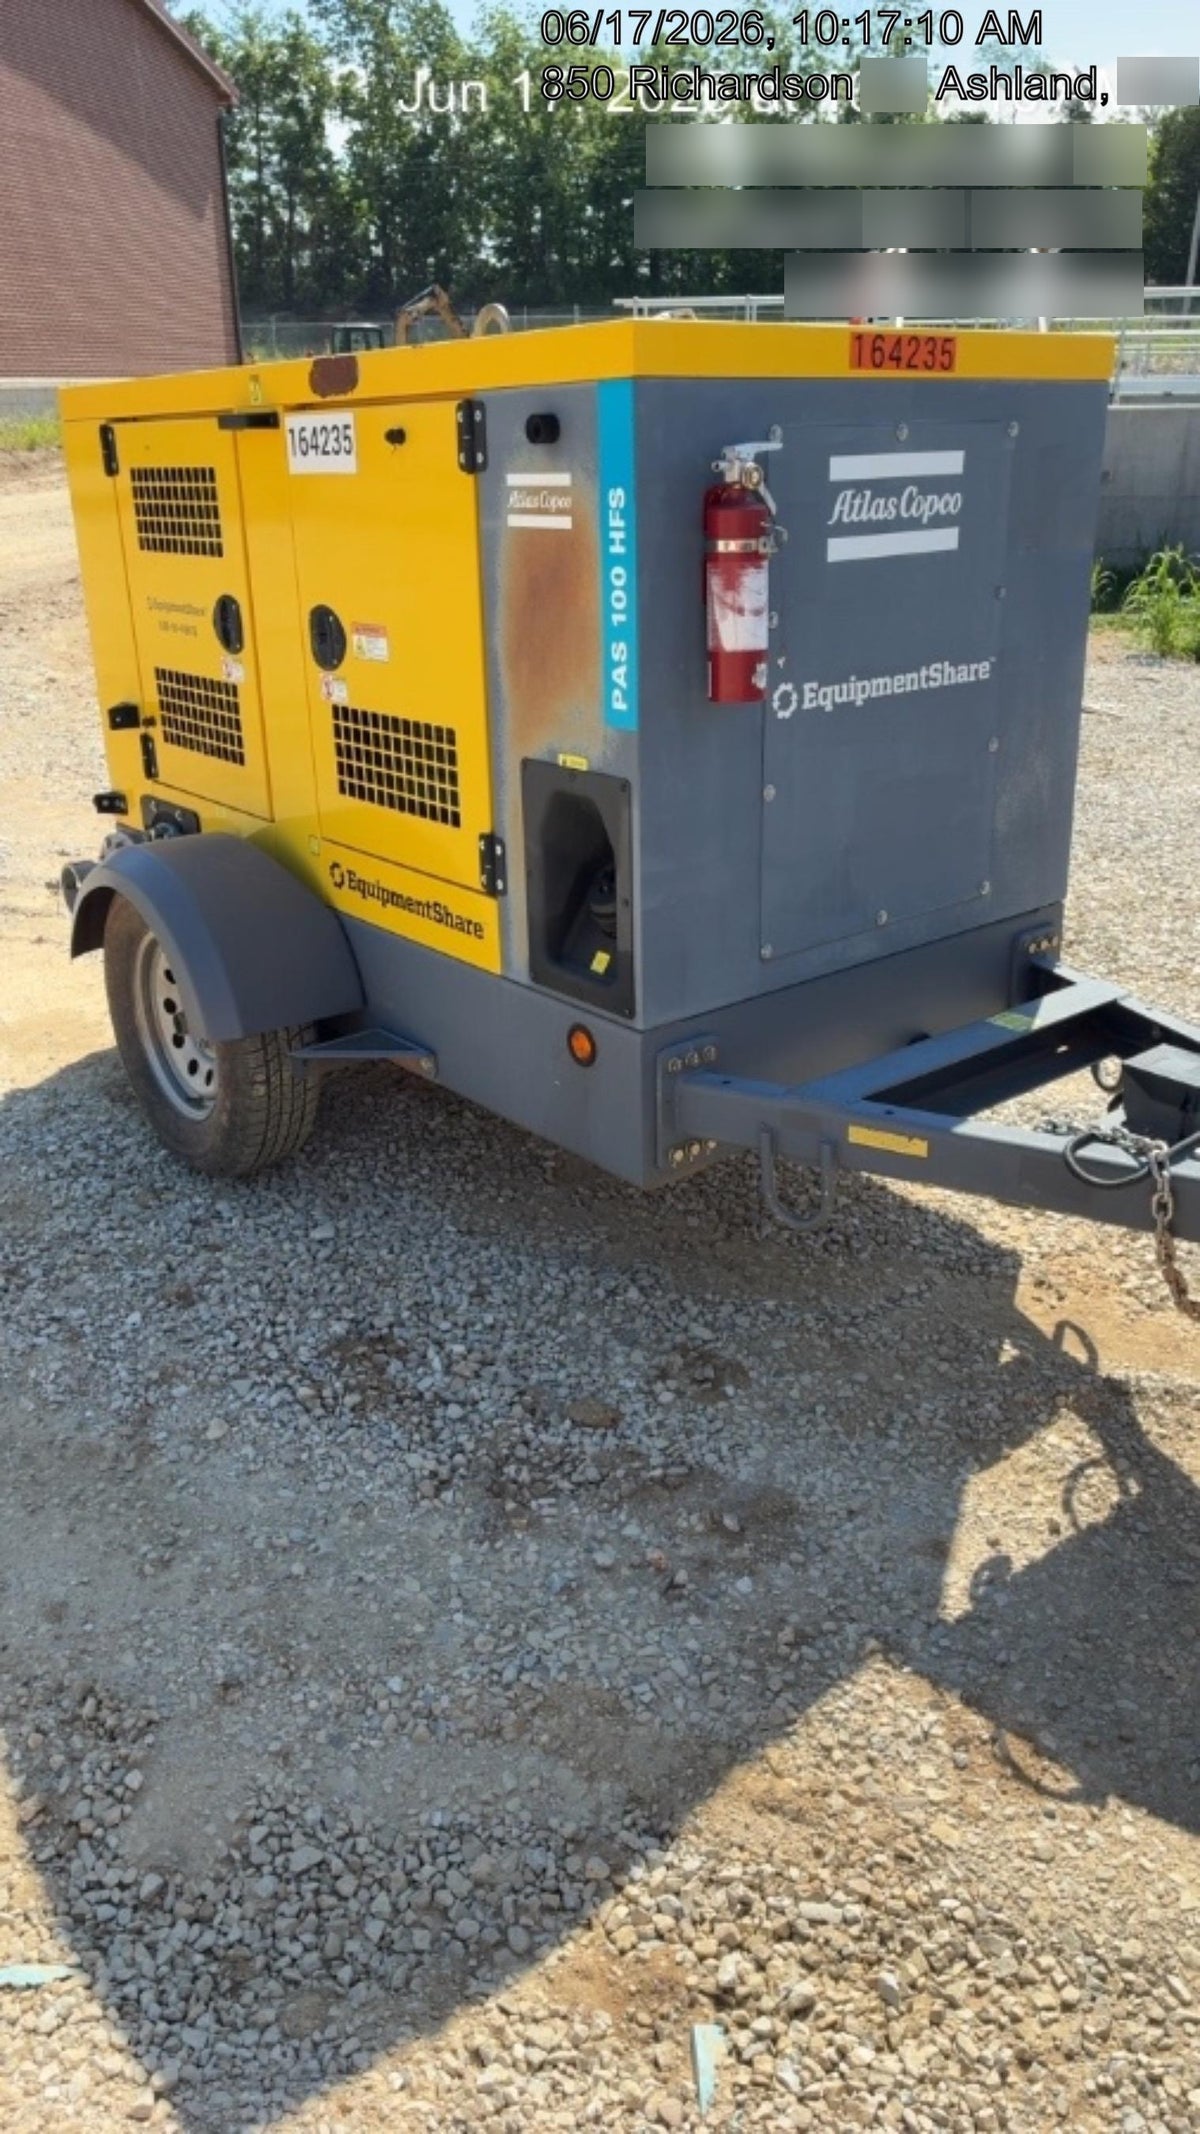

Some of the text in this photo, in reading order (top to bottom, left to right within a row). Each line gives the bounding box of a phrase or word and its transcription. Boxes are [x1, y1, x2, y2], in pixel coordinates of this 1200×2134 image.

[854, 333, 955, 371] 164235
[288, 423, 353, 457] 164235
[827, 485, 962, 525] Atlas Copco
[607, 486, 629, 712] PAS 100 HFS
[802, 660, 991, 712] EquipmentShare
[345, 868, 485, 940] EquipmentShare
